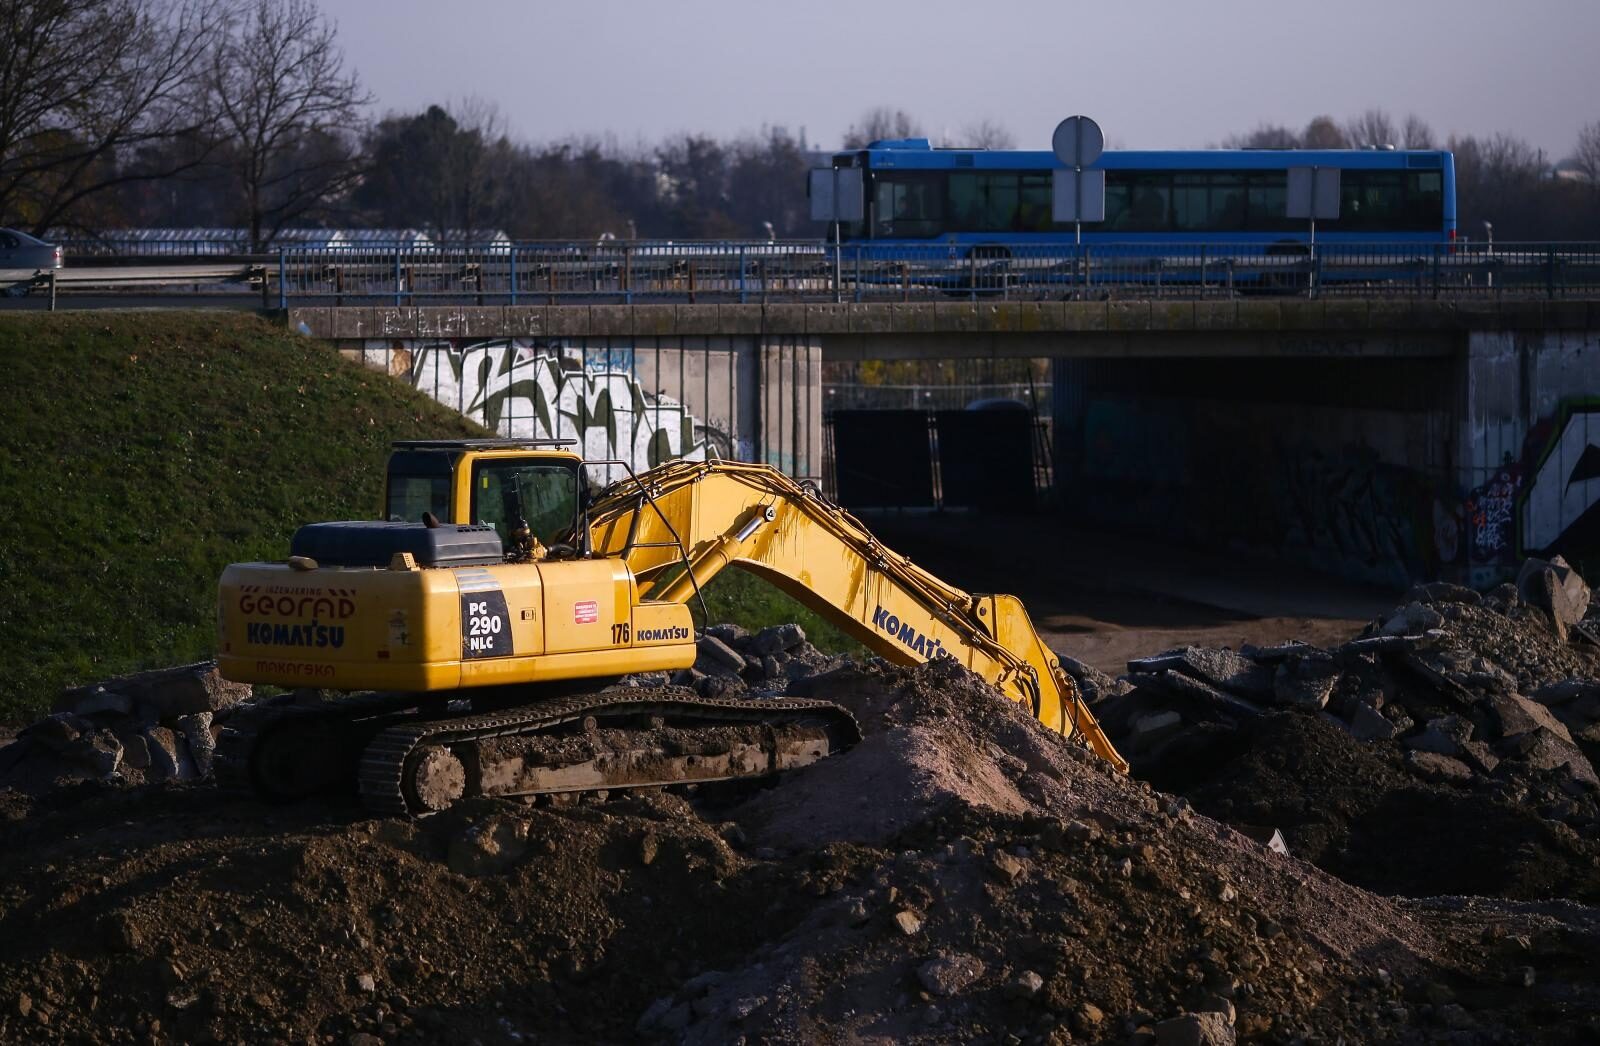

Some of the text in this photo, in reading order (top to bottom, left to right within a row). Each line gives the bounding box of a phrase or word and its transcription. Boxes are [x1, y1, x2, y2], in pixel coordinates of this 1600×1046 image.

[469, 602, 487, 616] PC
[247, 620, 345, 648] KOMATSU
[469, 616, 502, 635] 290
[611, 623, 630, 645] 176
[637, 626, 689, 641] KOMATSU
[470, 636, 494, 650] NLC
